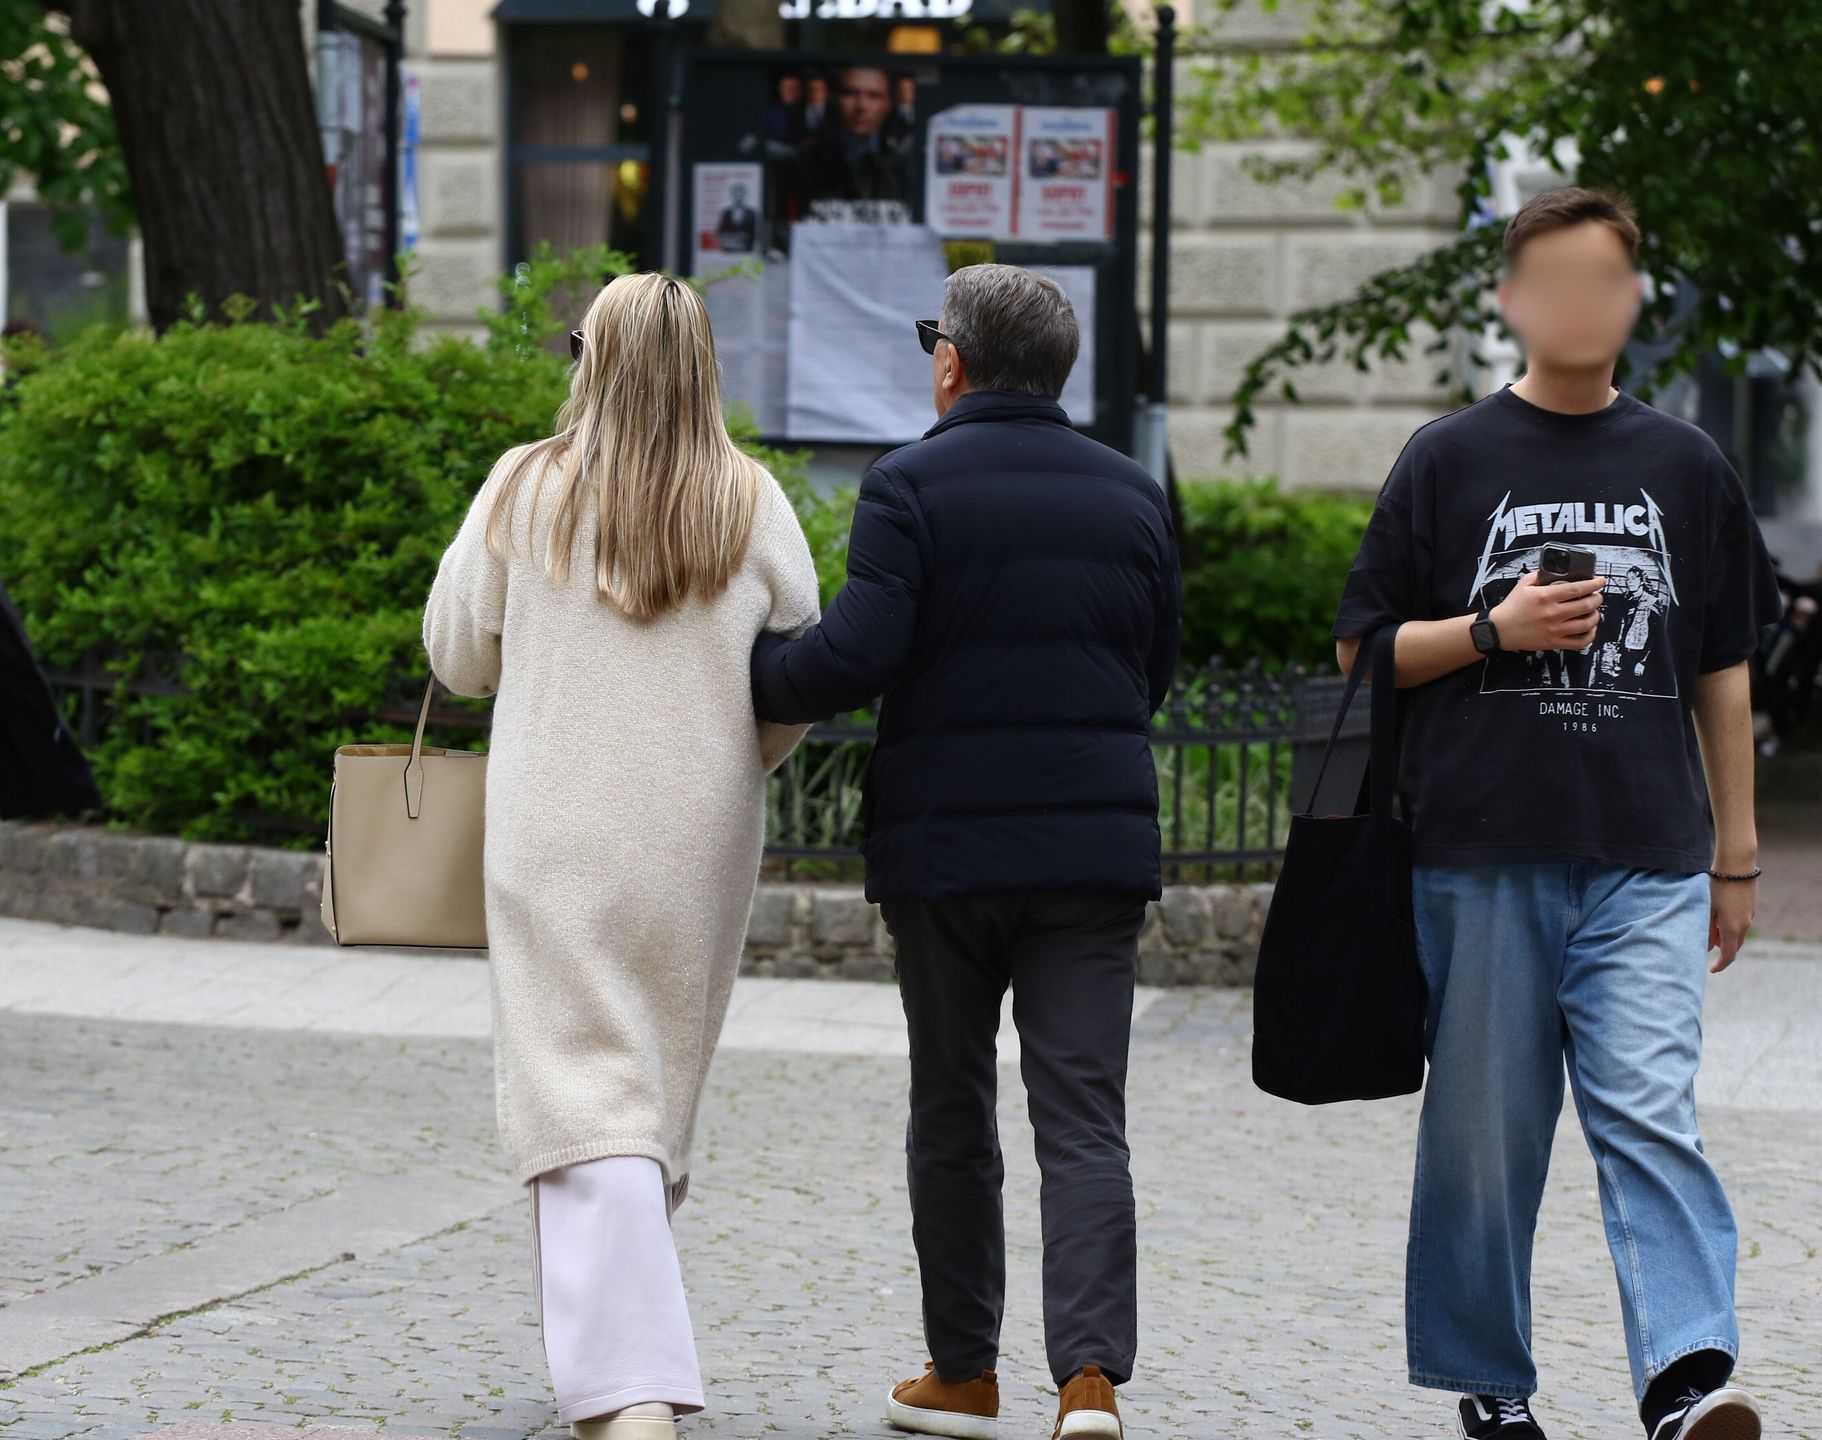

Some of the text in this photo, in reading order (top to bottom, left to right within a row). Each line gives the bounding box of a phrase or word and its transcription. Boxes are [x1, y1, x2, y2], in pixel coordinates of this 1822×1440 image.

[1467, 488, 1680, 607] METALLICA
[1539, 702, 1624, 719] DAMAGE INC.
[1563, 722, 1597, 733] 1986
